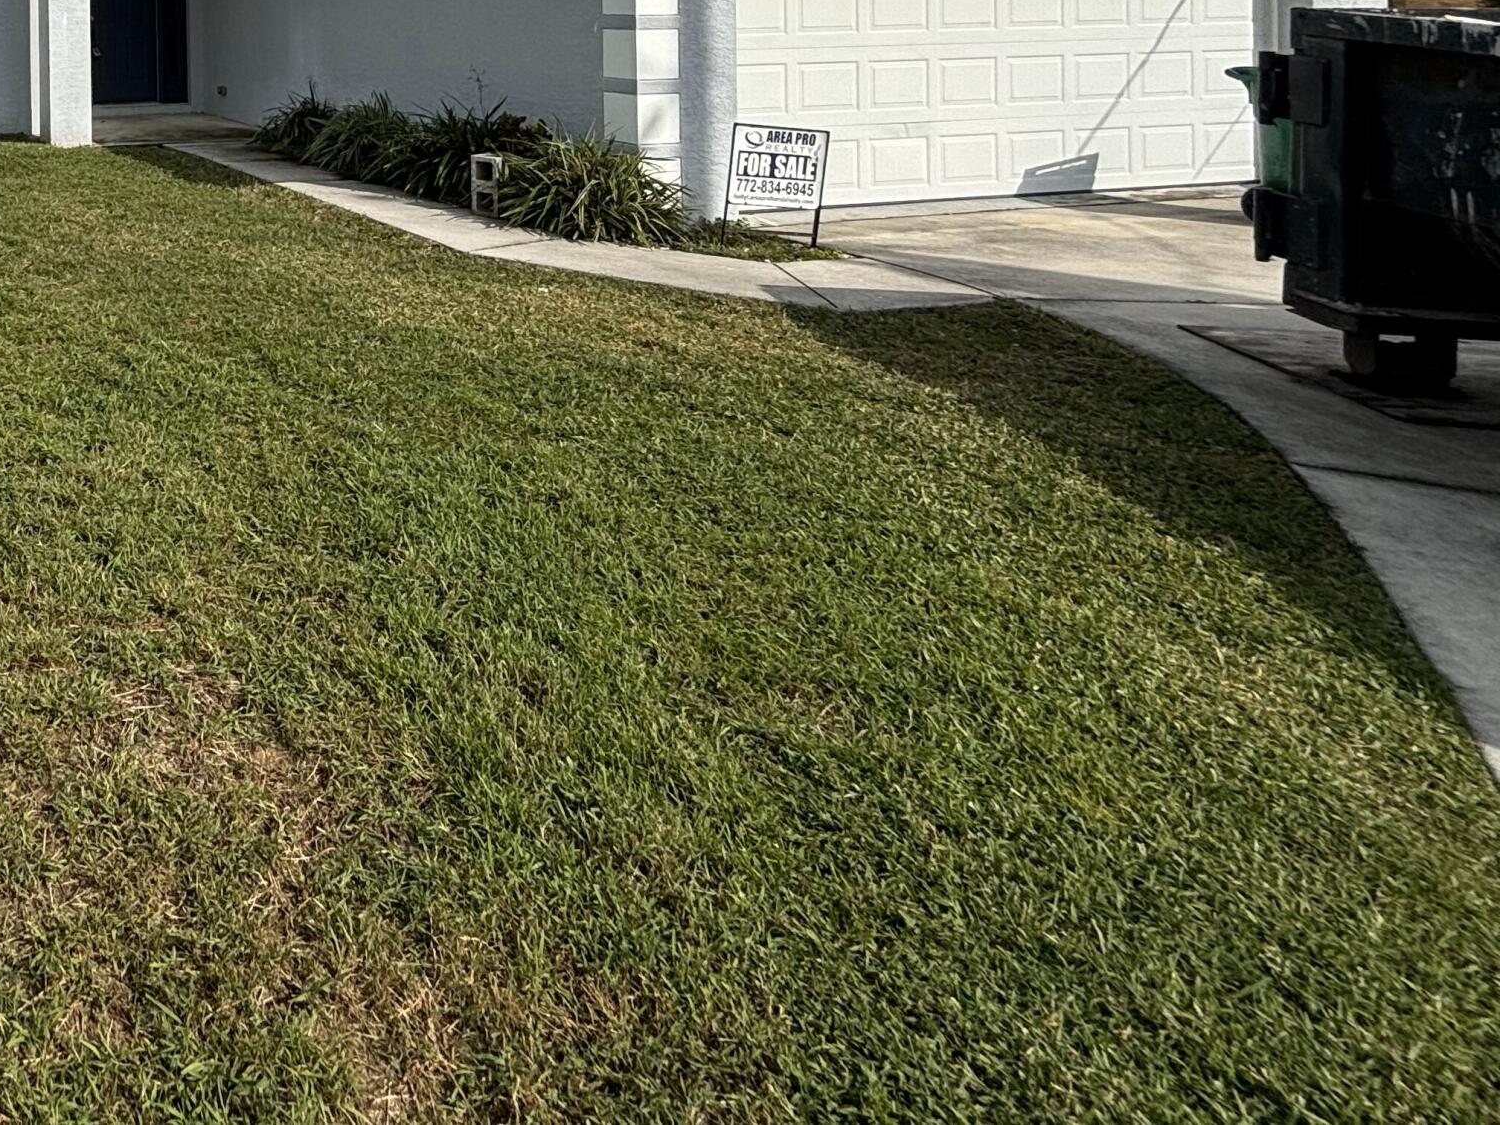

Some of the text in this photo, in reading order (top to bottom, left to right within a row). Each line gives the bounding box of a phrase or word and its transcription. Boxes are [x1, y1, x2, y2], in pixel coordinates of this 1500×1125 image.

[766, 130, 816, 147] AREA PRO
[765, 144, 814, 154] REALTY
[738, 153, 817, 181] FOR SALE
[736, 178, 814, 197] 772-834-6945
